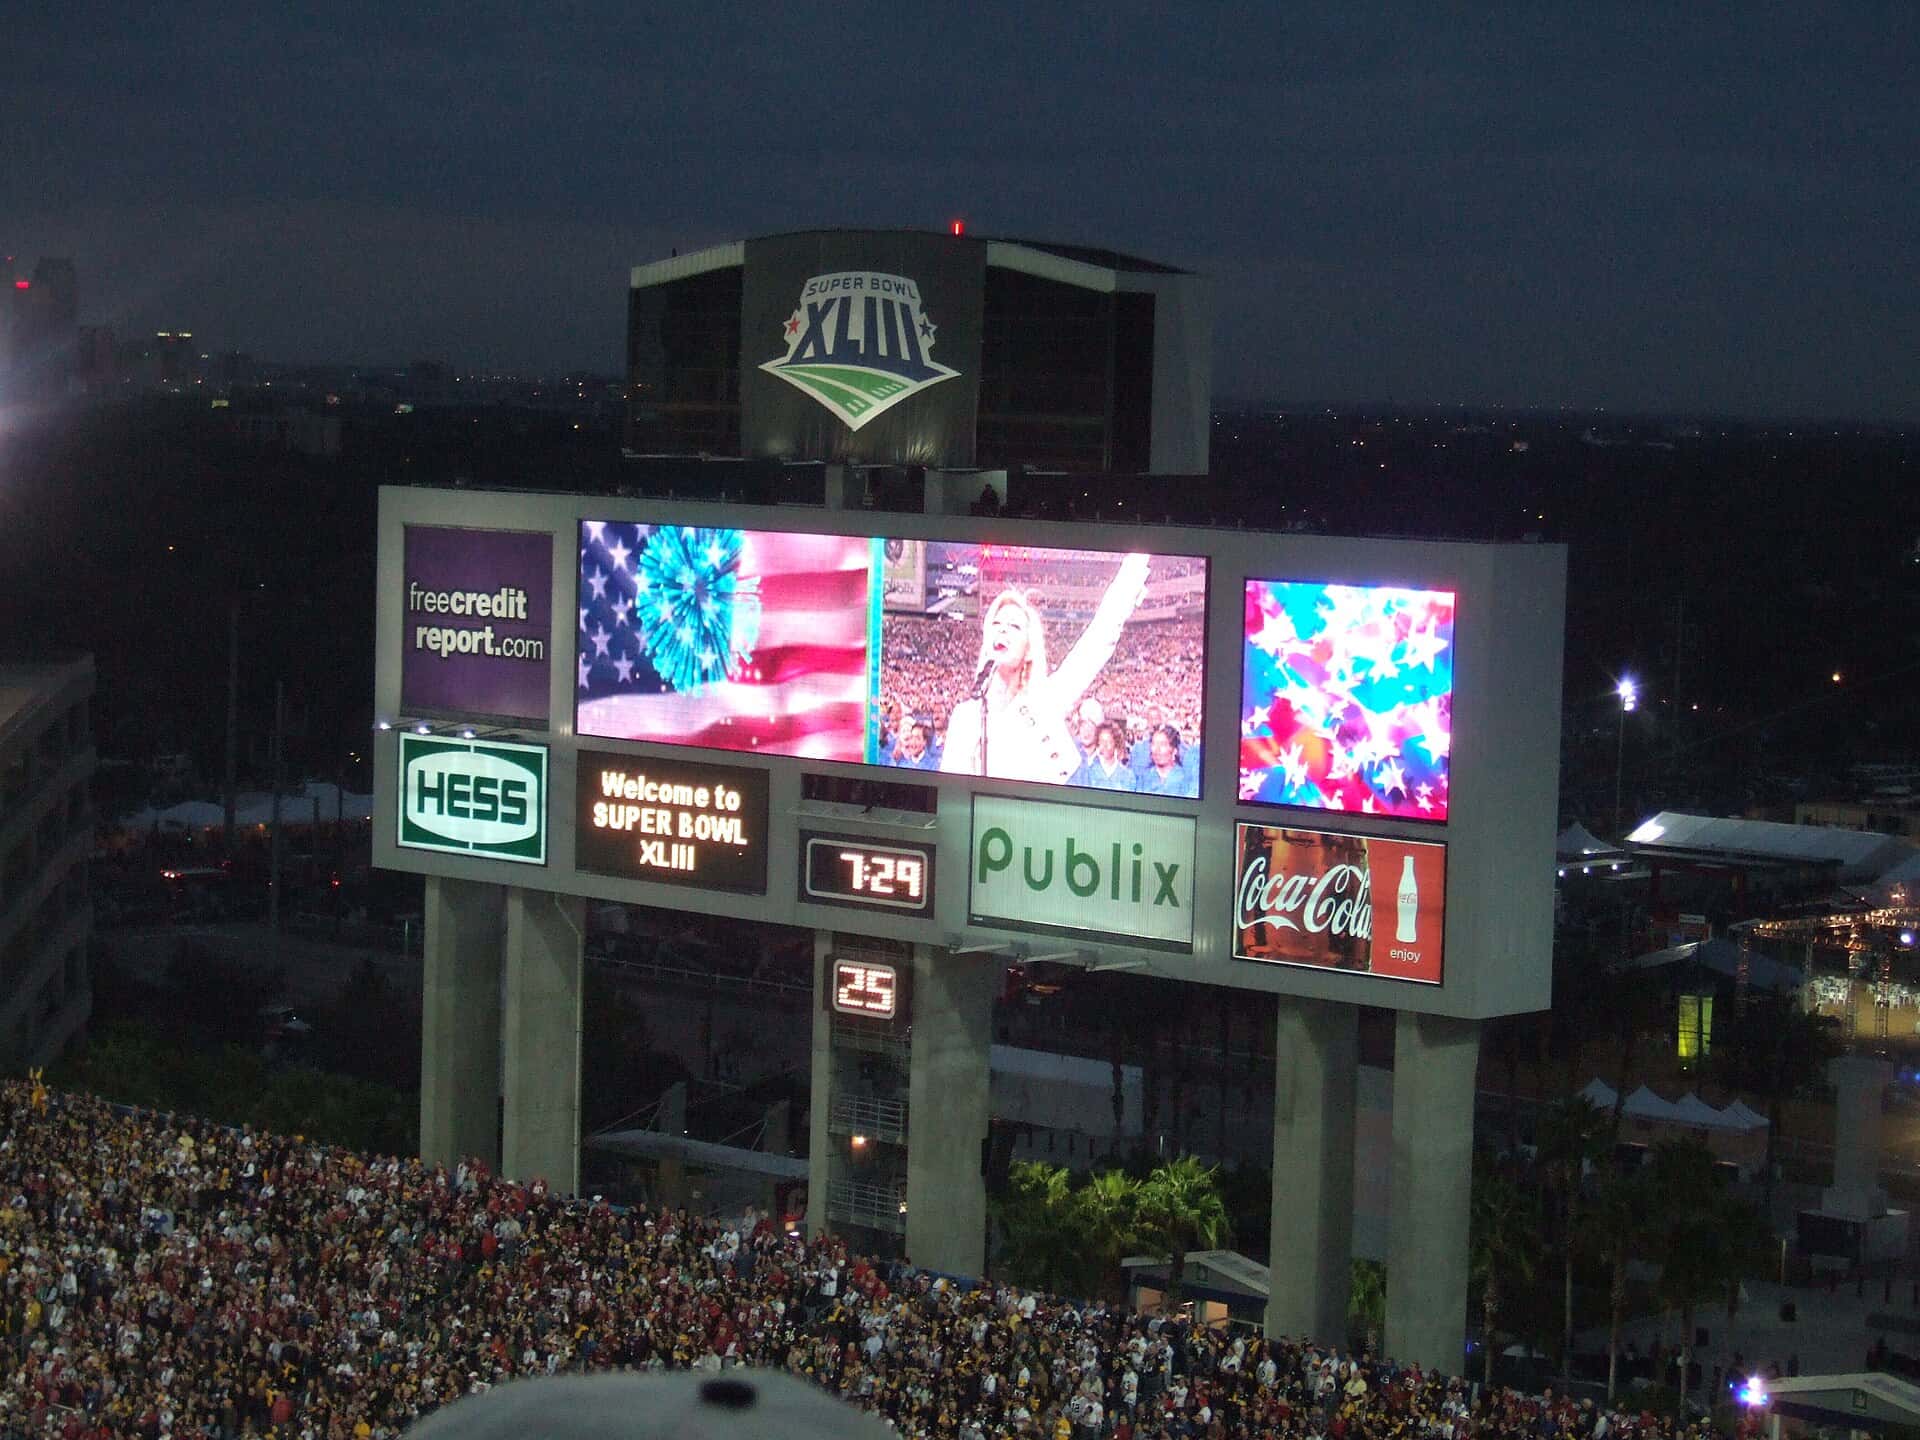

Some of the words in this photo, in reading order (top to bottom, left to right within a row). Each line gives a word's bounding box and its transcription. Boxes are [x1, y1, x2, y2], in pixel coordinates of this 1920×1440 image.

[806, 277, 864, 297] SUPER
[870, 279, 917, 299] BOWL
[410, 582, 527, 619] freecredit
[416, 625, 543, 660] report.com
[417, 769, 528, 826] HESS
[602, 772, 710, 808] Welcome
[716, 784, 741, 812] to
[593, 803, 673, 837] SUPER
[678, 816, 748, 845] BOWL
[639, 839, 696, 871] XLIII
[840, 852, 922, 898] 7:29
[978, 827, 1180, 908] Publix
[1390, 948, 1421, 964] enjoy
[837, 965, 893, 1012] 25
